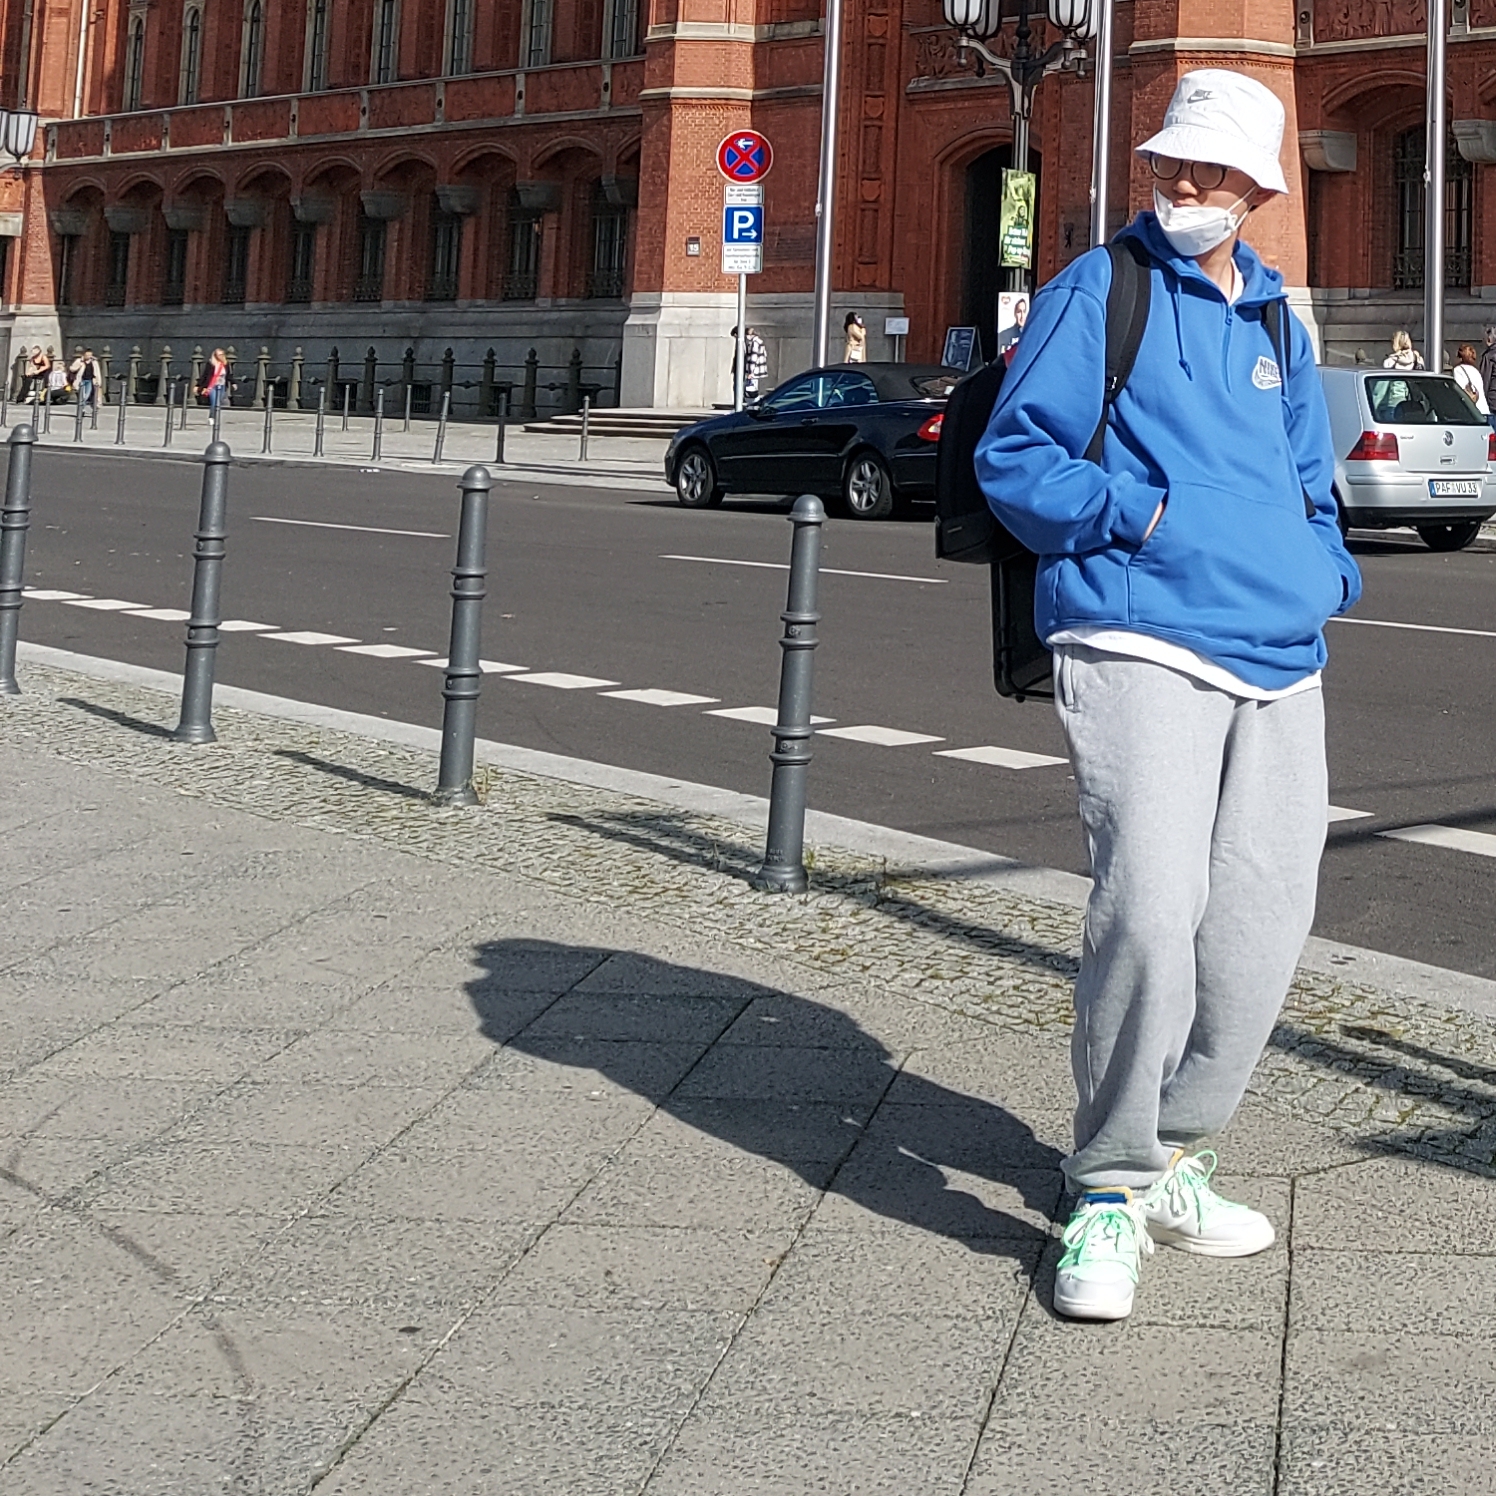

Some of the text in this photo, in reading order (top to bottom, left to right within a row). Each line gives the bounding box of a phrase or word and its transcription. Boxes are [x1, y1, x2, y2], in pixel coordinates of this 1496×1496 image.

[732, 210, 755, 240] P
[1435, 482, 1450, 494] PAF
[1455, 482, 1467, 494] VU
